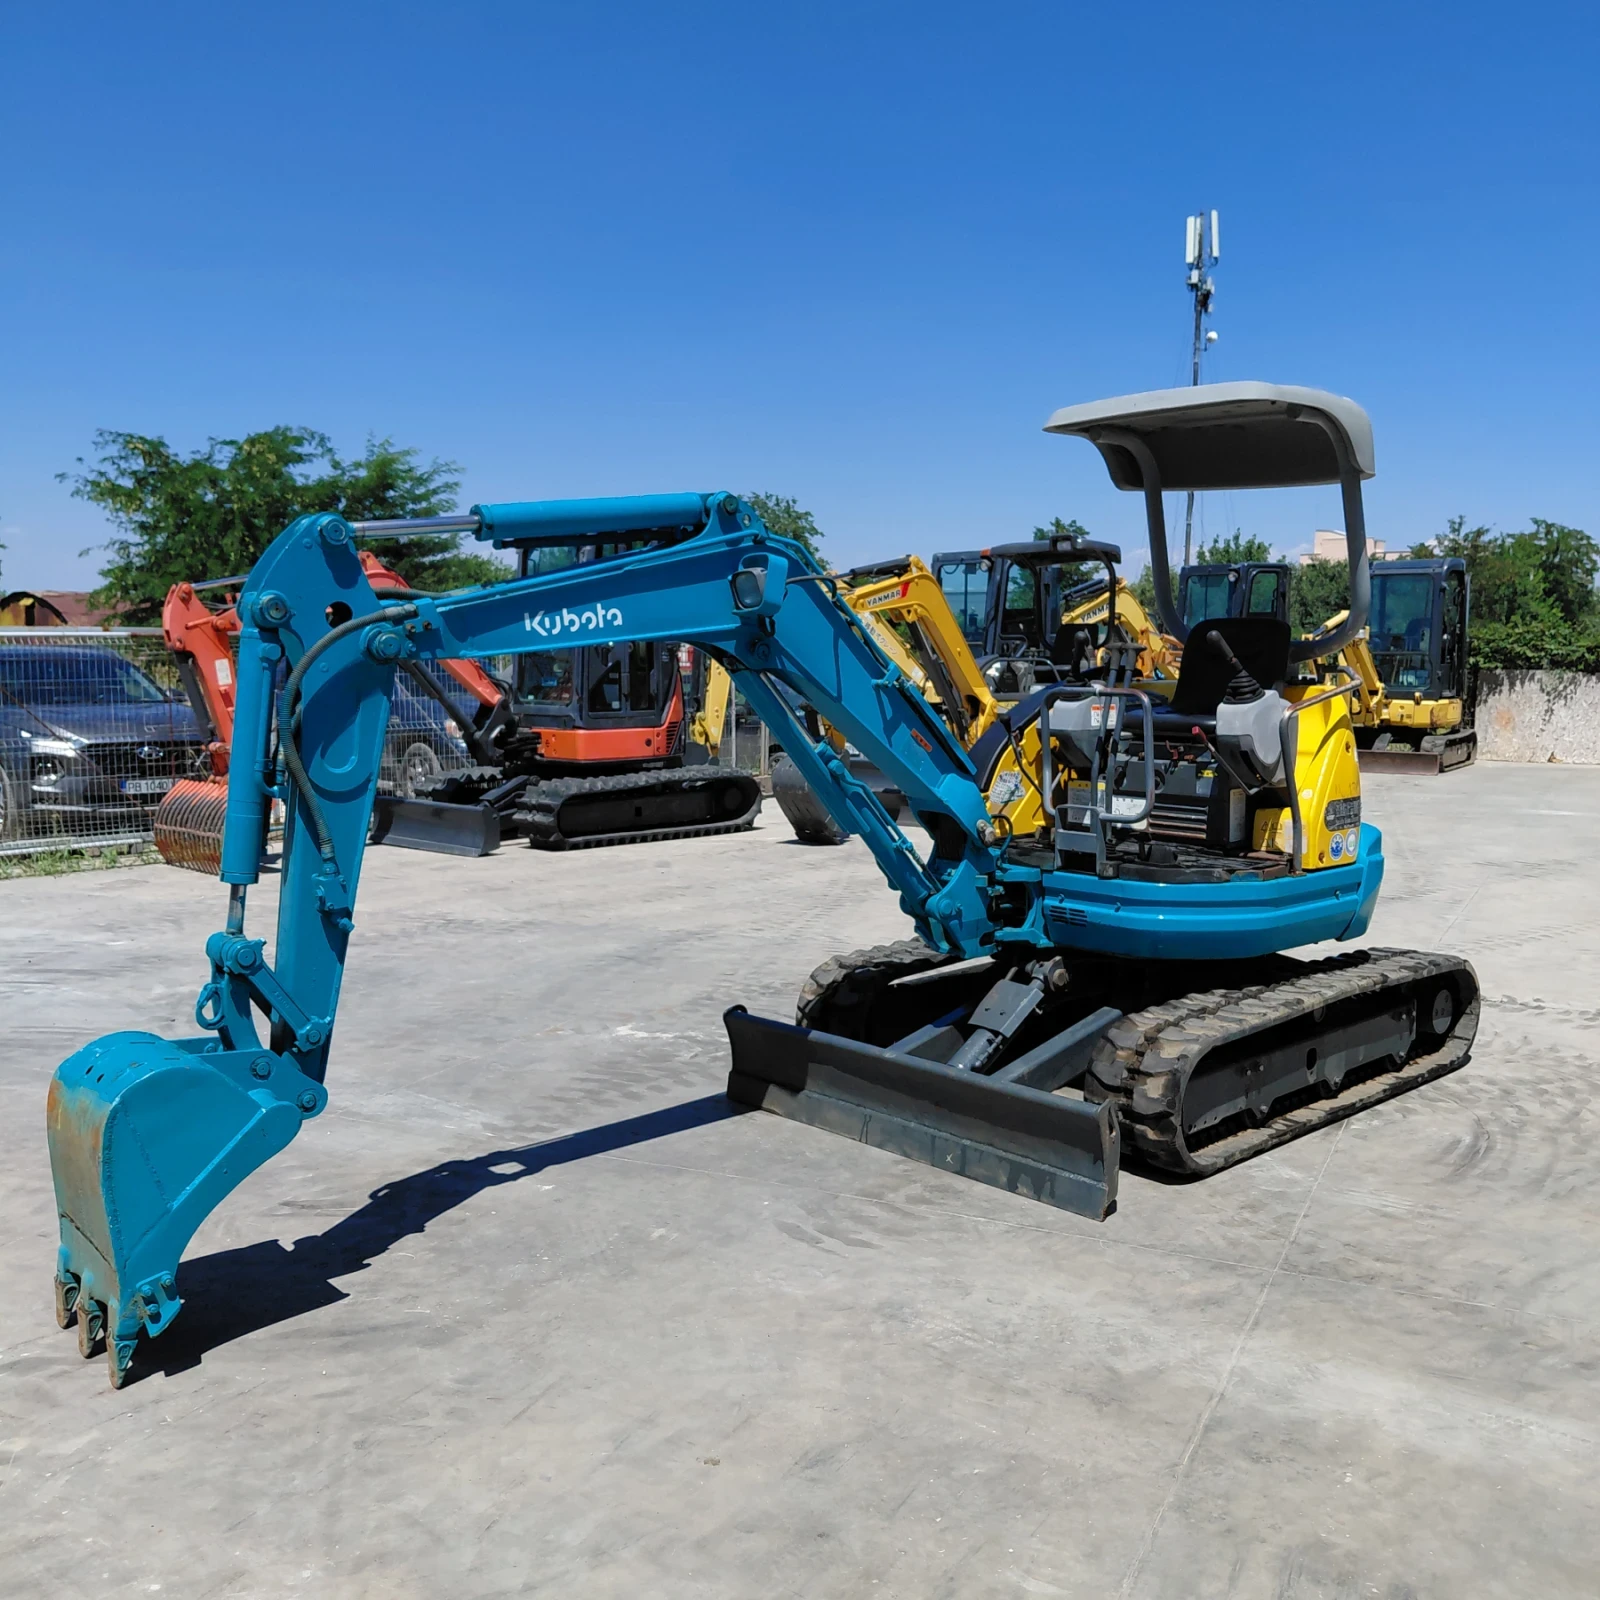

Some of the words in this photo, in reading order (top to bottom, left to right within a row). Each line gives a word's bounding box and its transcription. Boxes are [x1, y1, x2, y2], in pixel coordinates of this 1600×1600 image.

[866, 588, 901, 607] YANMAR
[523, 602, 623, 637] Kubota
[127, 781, 142, 792] PB
[144, 780, 169, 791] 1040
